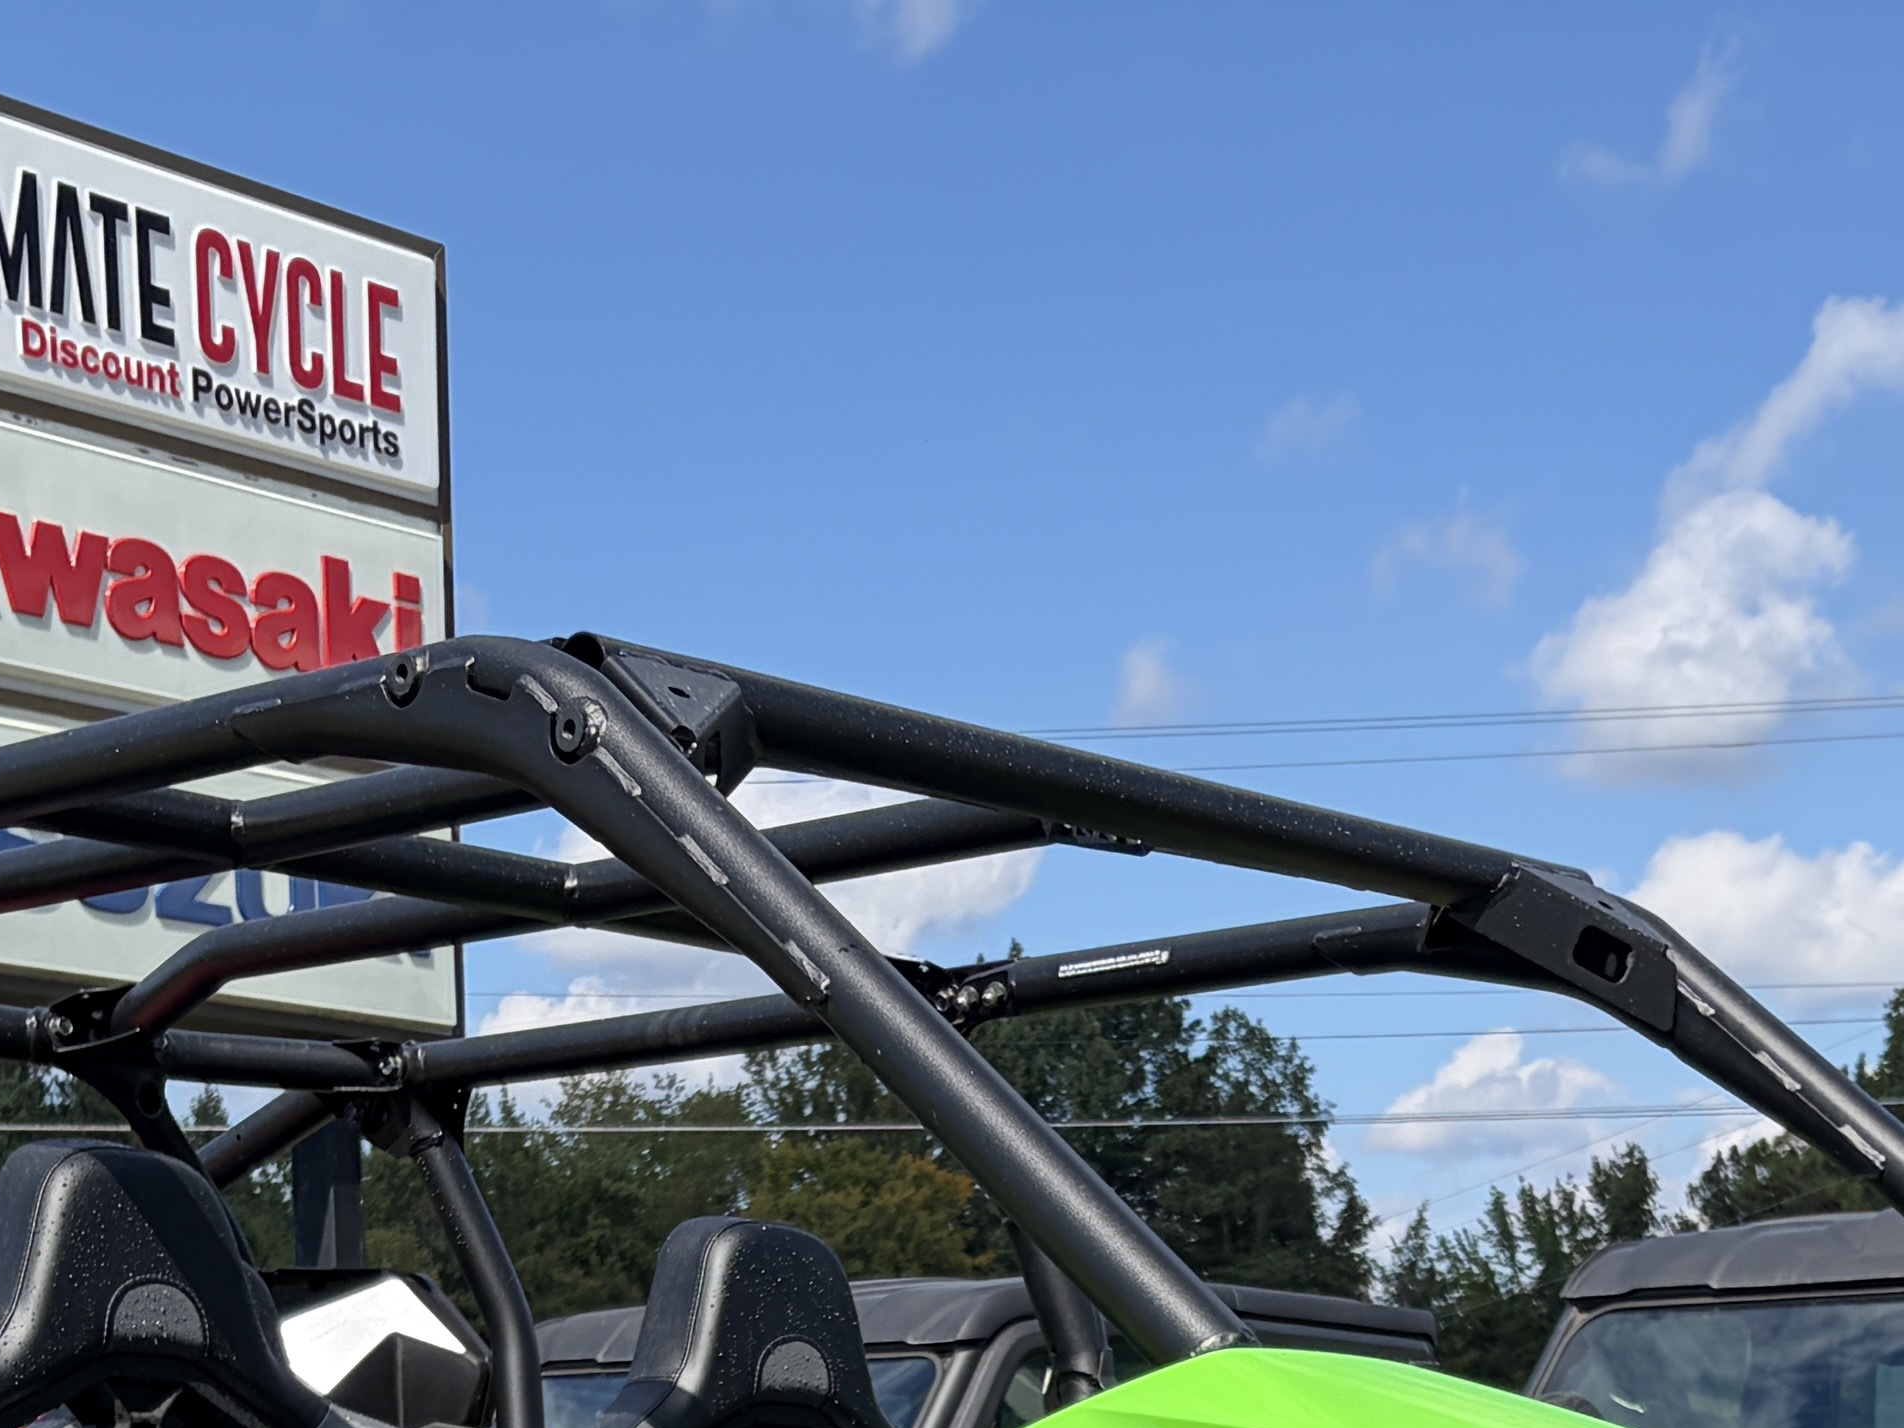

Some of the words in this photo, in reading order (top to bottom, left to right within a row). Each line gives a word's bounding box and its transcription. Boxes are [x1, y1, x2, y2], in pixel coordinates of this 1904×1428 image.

[22, 318, 181, 399] Discount
[192, 366, 402, 460] PowerSports
[194, 227, 404, 414] CYCLE
